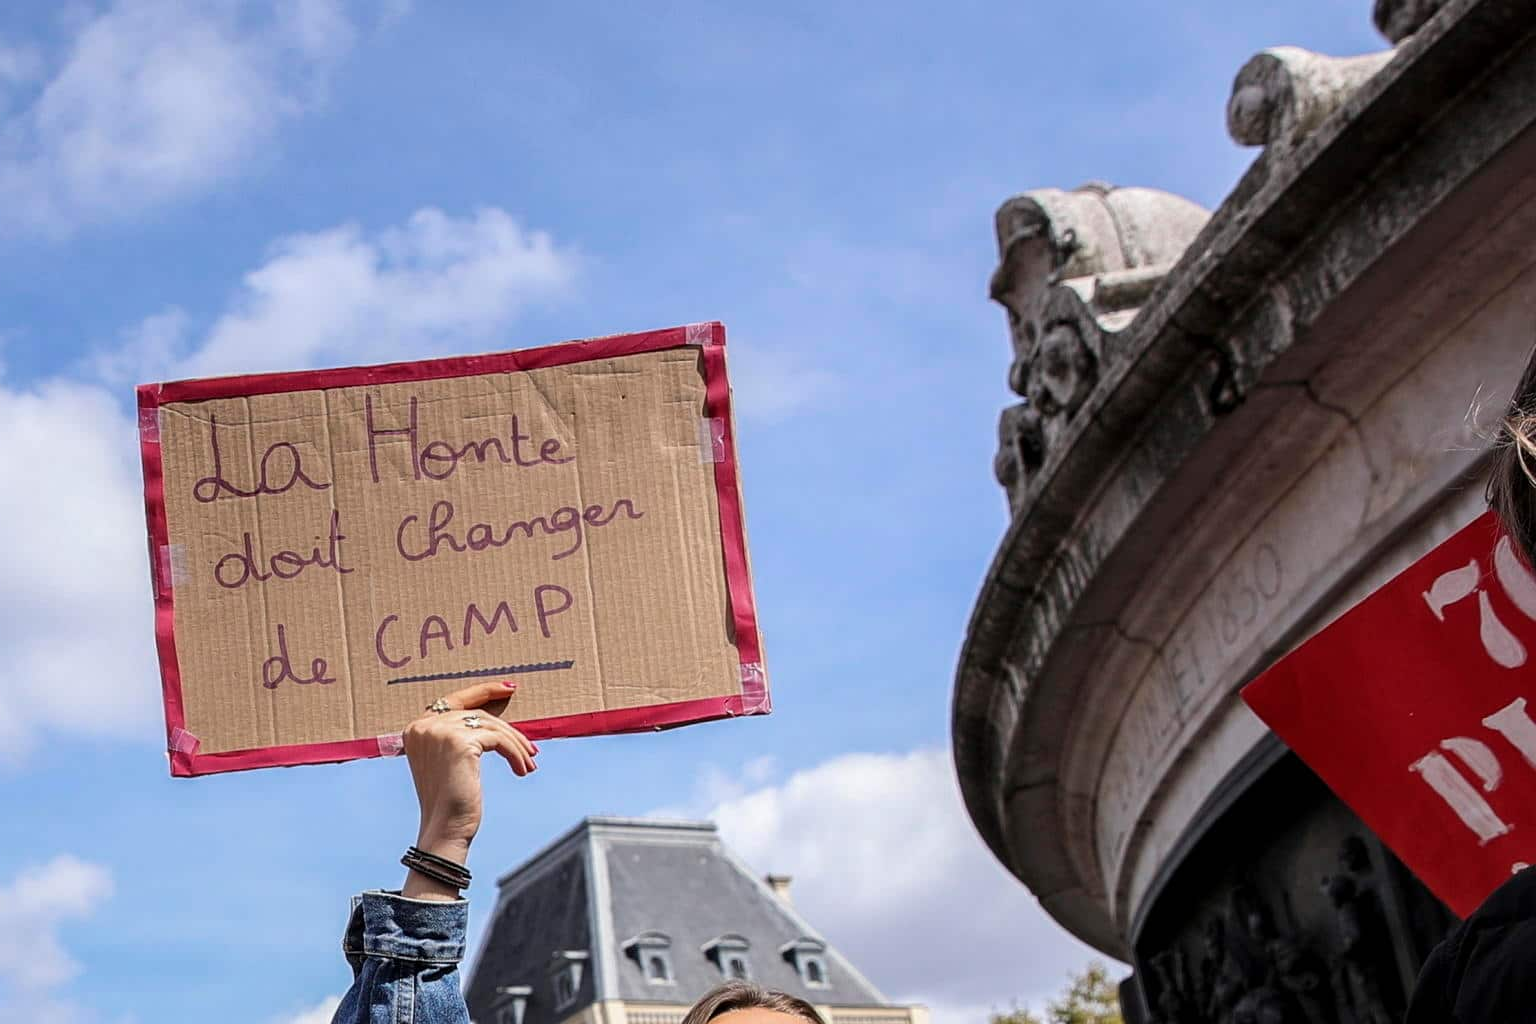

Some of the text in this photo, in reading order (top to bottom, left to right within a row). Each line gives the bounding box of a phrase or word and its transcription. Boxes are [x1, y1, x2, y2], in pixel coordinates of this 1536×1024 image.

[193, 392, 576, 503] La Honte
[214, 510, 355, 590] doit
[262, 584, 574, 690] de CAMP
